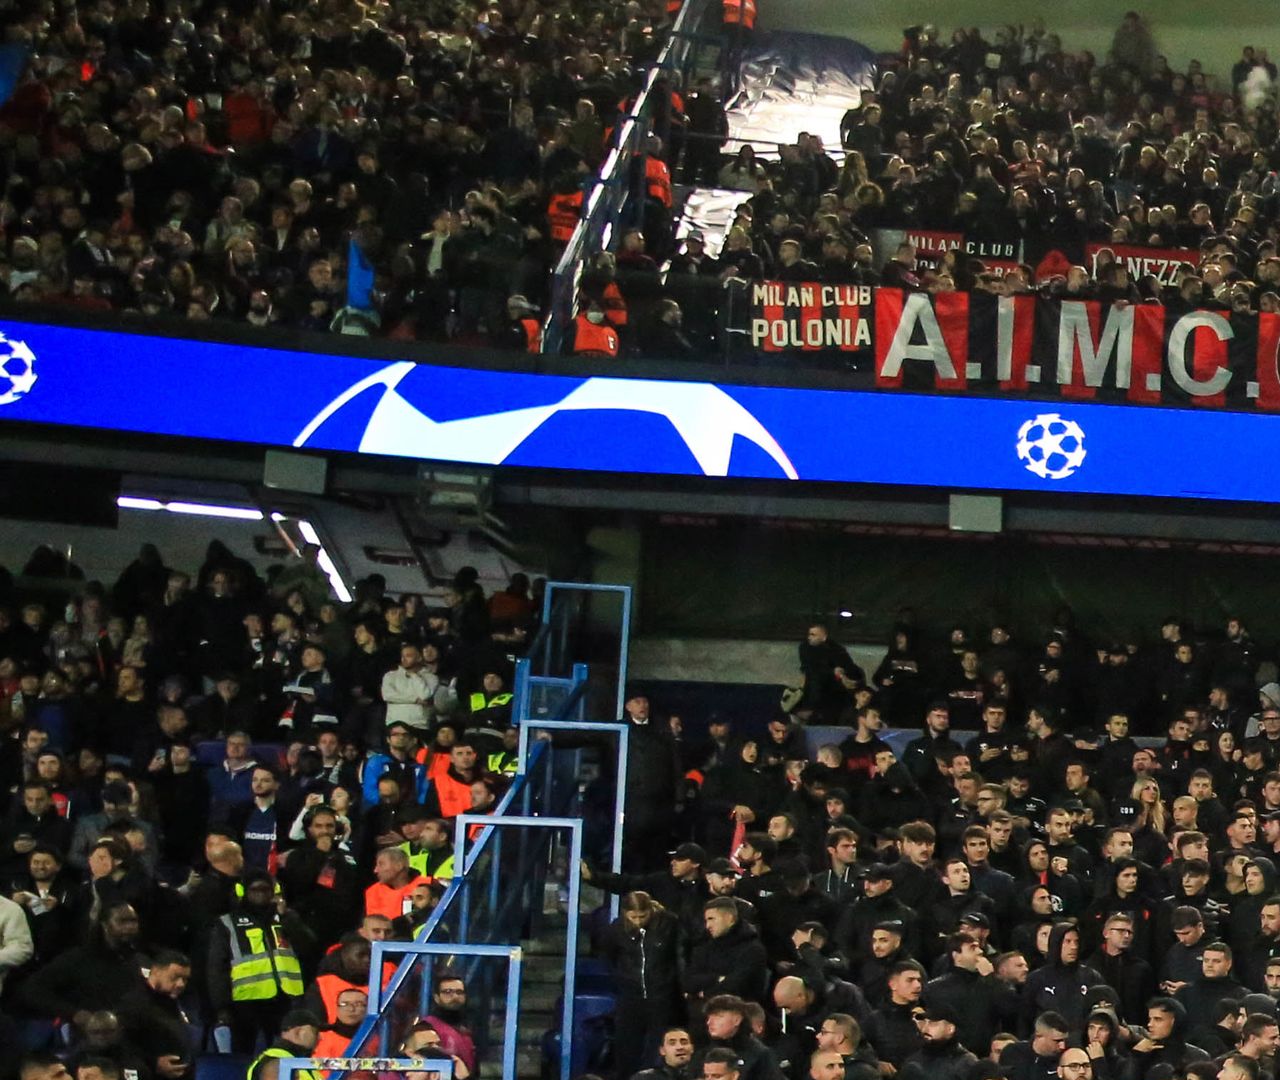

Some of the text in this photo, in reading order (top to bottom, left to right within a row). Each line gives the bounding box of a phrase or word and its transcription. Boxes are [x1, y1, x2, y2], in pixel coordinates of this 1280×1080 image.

[909, 234, 1014, 257] MILAN CLUB
[753, 284, 871, 308] MILAN CLUB
[752, 318, 872, 348] POLONIA
[880, 292, 1260, 398] A.I.M.C.
